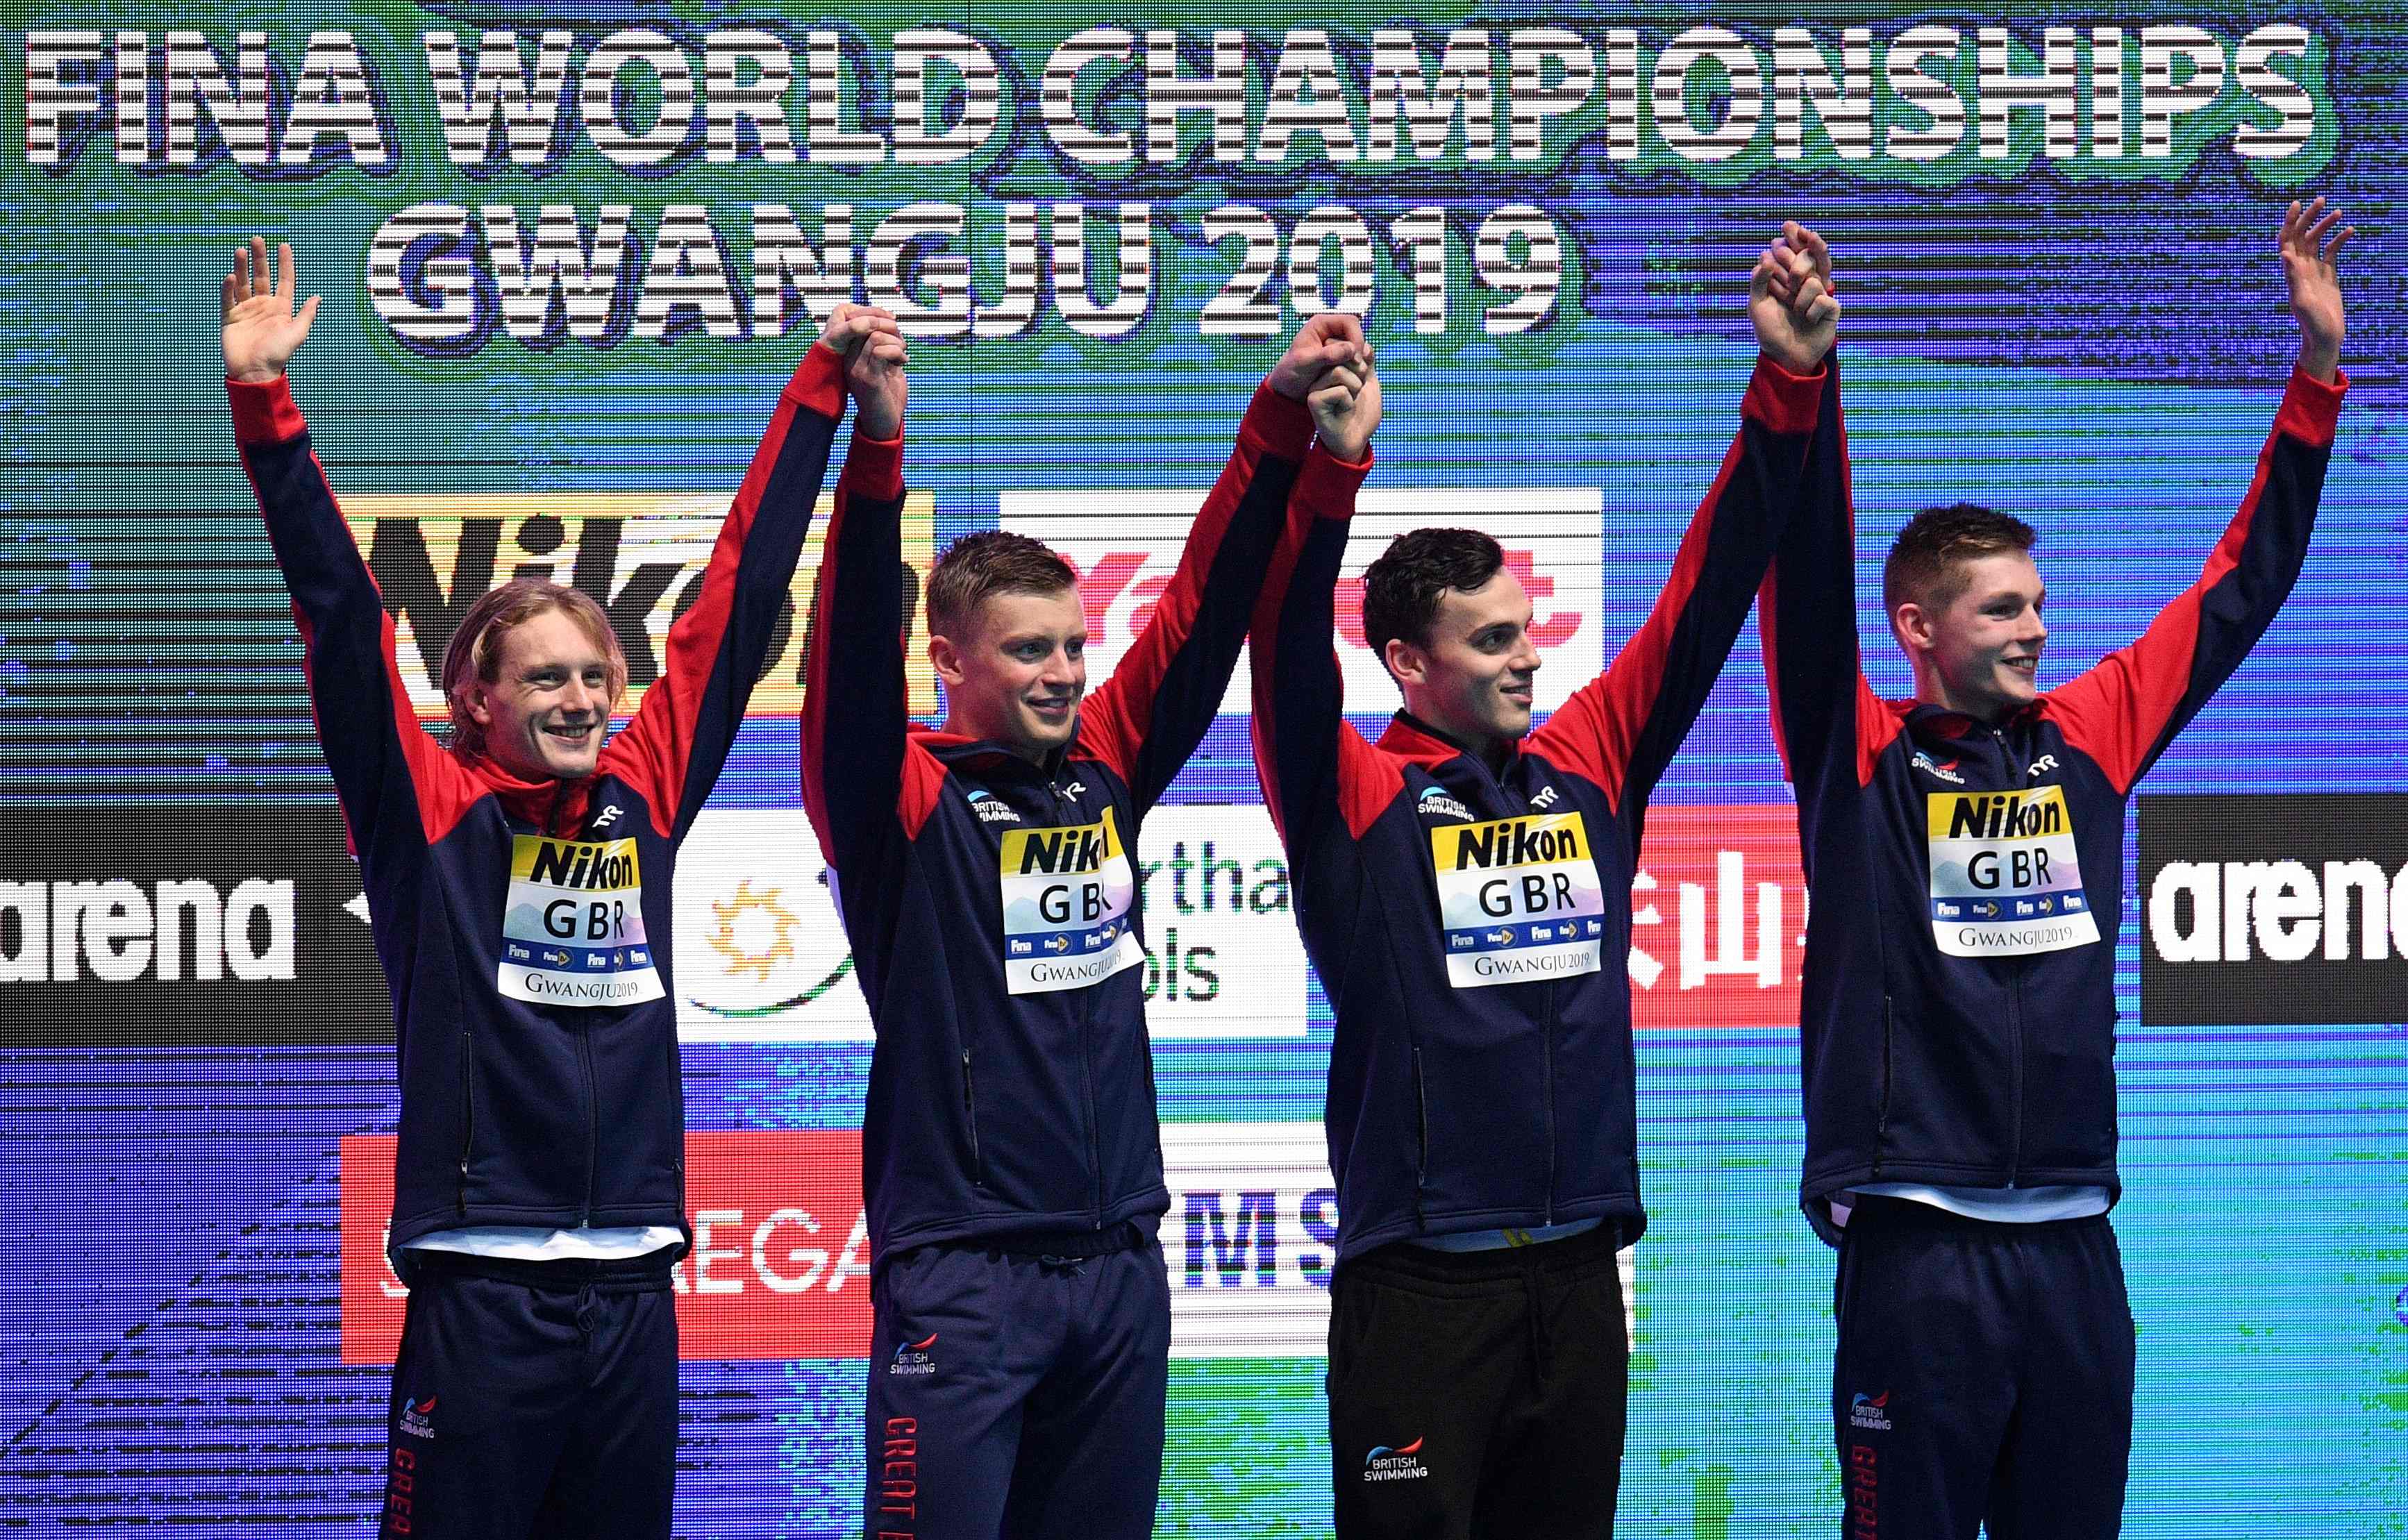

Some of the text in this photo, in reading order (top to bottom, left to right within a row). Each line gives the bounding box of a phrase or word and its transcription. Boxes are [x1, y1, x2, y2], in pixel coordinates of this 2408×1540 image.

[26, 24, 2315, 164] FINA WORLD CHAMPIONSHIPS
[369, 201, 1562, 337] GWANGJU 2019
[1418, 803, 1475, 822] SWIMMING
[1427, 796, 1466, 812] BRITISH
[1948, 796, 2061, 839] Nikon
[529, 842, 633, 889] Nikon
[1020, 826, 1109, 874] Nik
[1456, 821, 1578, 871] Nikon
[1967, 847, 2052, 890] GBR
[1479, 872, 1575, 917] GBR
[2150, 858, 2408, 962] aren
[0, 878, 296, 981] arena
[544, 900, 624, 940] GBR
[889, 1363, 936, 1375] SWIMMING
[898, 1353, 928, 1364] BRITISH
[880, 1417, 917, 1521] GREAT
[1364, 1466, 1428, 1482] SWIMMING
[1372, 1457, 1417, 1470] BRITISH
